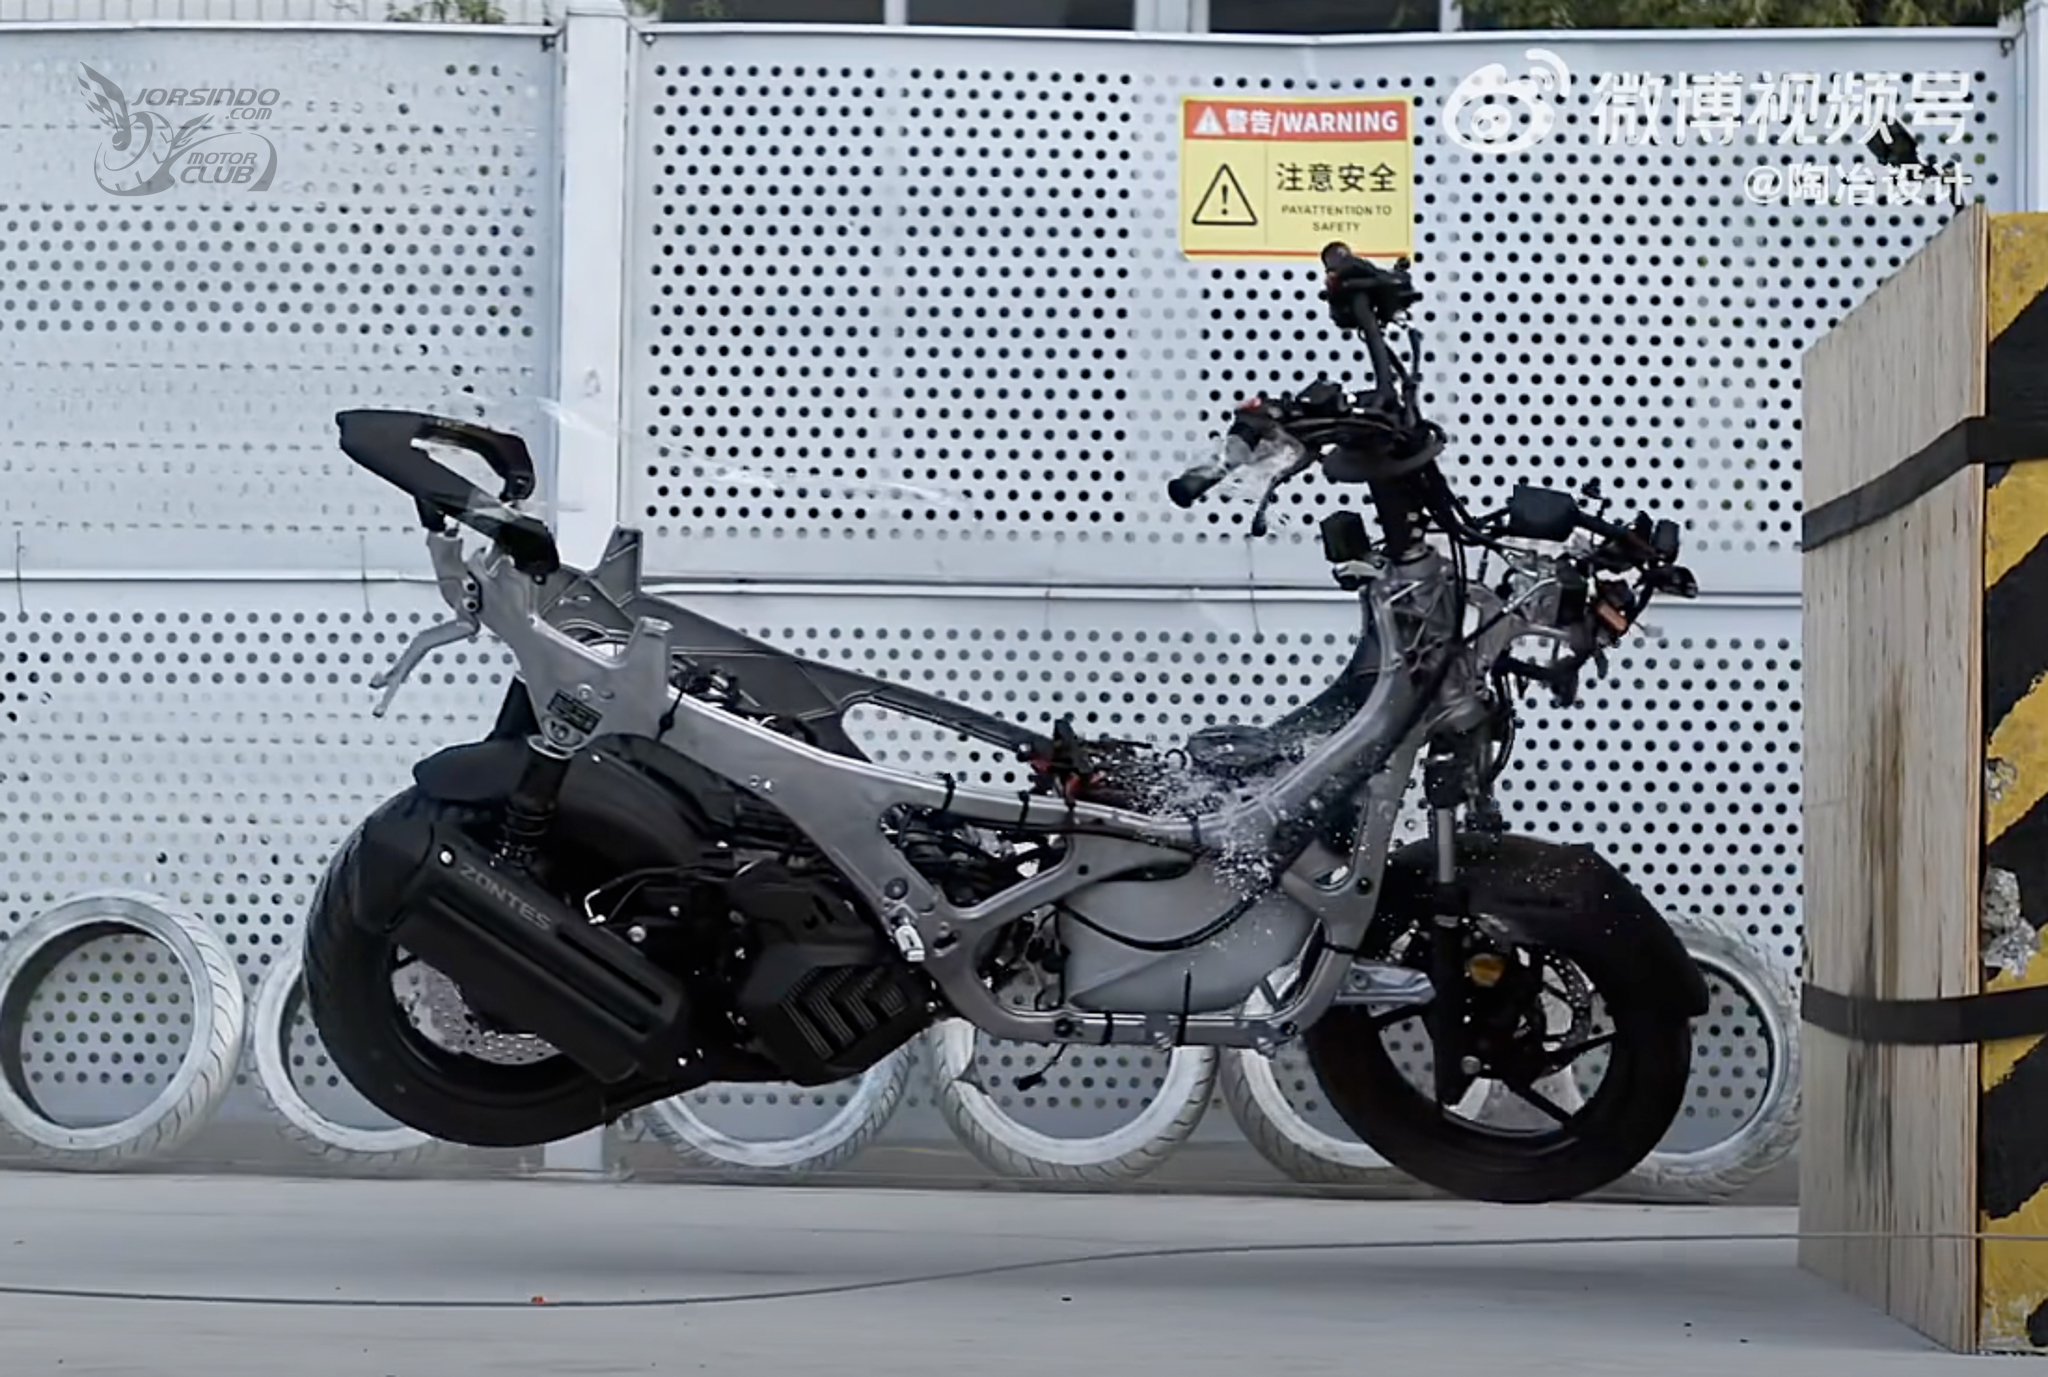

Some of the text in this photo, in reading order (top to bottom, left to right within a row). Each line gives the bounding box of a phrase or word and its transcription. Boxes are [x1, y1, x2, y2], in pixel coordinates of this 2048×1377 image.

[1277, 163, 1397, 192] 注意安全
[1376, 205, 1392, 215] TO
[1312, 221, 1361, 233] SAFETY
[459, 862, 551, 931] ZONTES
